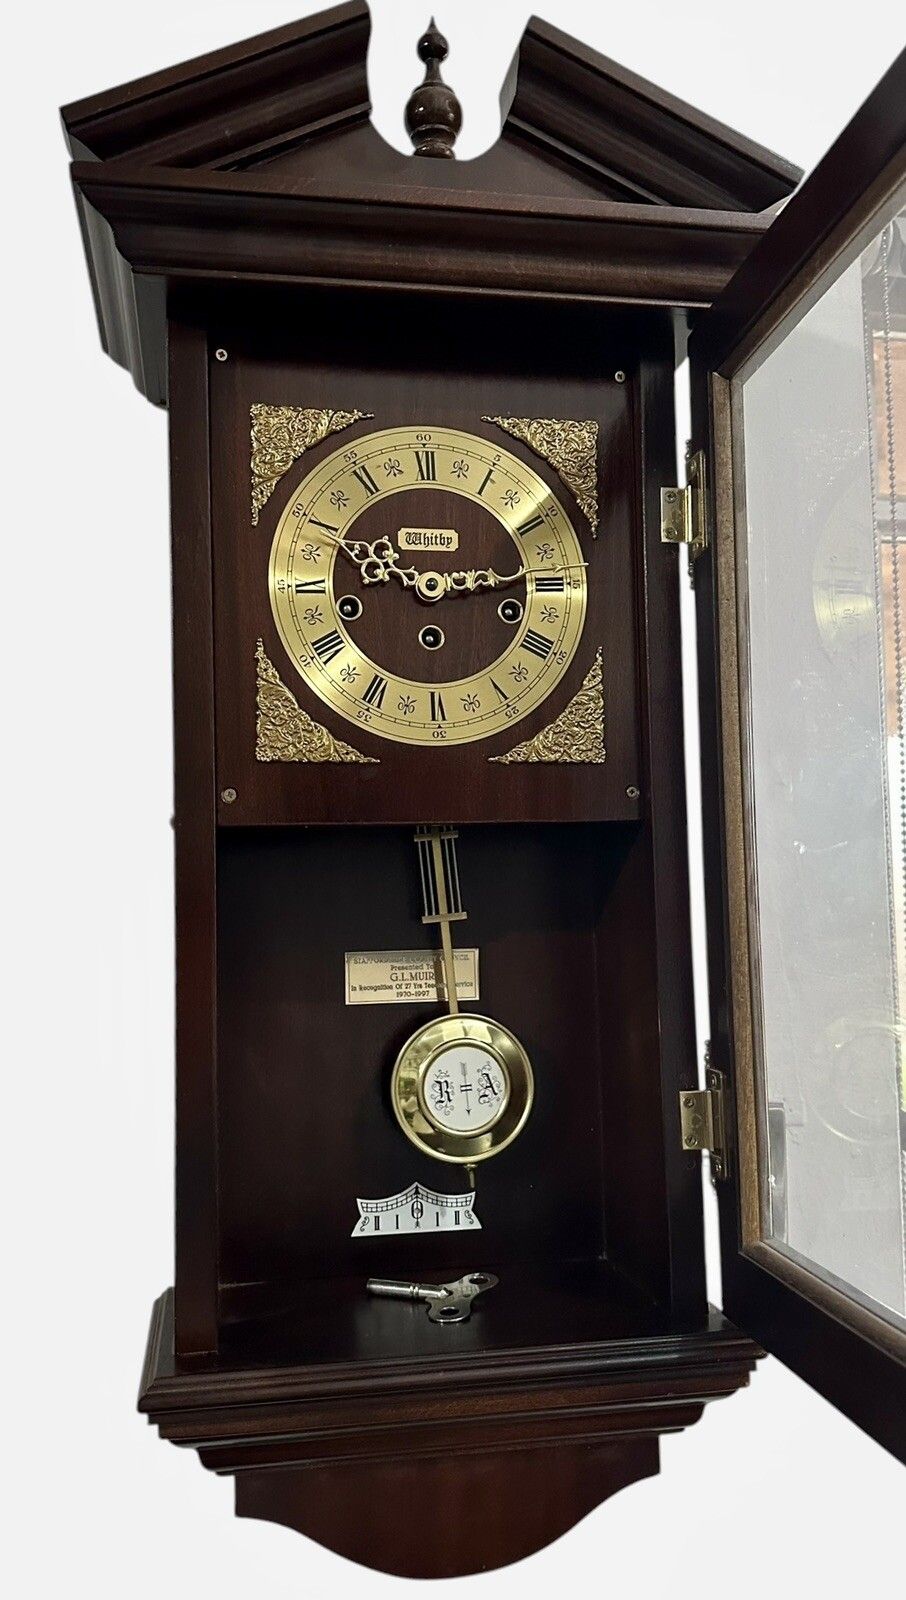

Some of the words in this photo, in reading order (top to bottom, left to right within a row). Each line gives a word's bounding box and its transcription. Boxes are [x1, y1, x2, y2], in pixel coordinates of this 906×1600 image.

[344, 450, 358, 462] 55
[493, 454, 502, 462] 5
[414, 450, 438, 482] XII
[351, 464, 382, 499] XI
[292, 502, 304, 518] 50
[547, 505, 558, 518] 10
[308, 513, 340, 537] X
[516, 514, 545, 538] II
[404, 532, 452, 548] Whitby
[277, 578, 286, 594] 45
[294, 578, 326, 595] IX
[535, 576, 564, 592] III
[572, 579, 580, 590] 15
[310, 628, 346, 666] VIII
[520, 628, 555, 662] IIII
[300, 654, 312, 668] 40
[556, 650, 568, 665] 20
[361, 672, 388, 710] VII
[488, 676, 510, 704] V
[428, 691, 447, 722] VI
[504, 706, 520, 718] 25
[356, 710, 372, 722] 35
[390, 972, 435, 982] G.L.MUIR
[359, 984, 394, 992] Recognition
